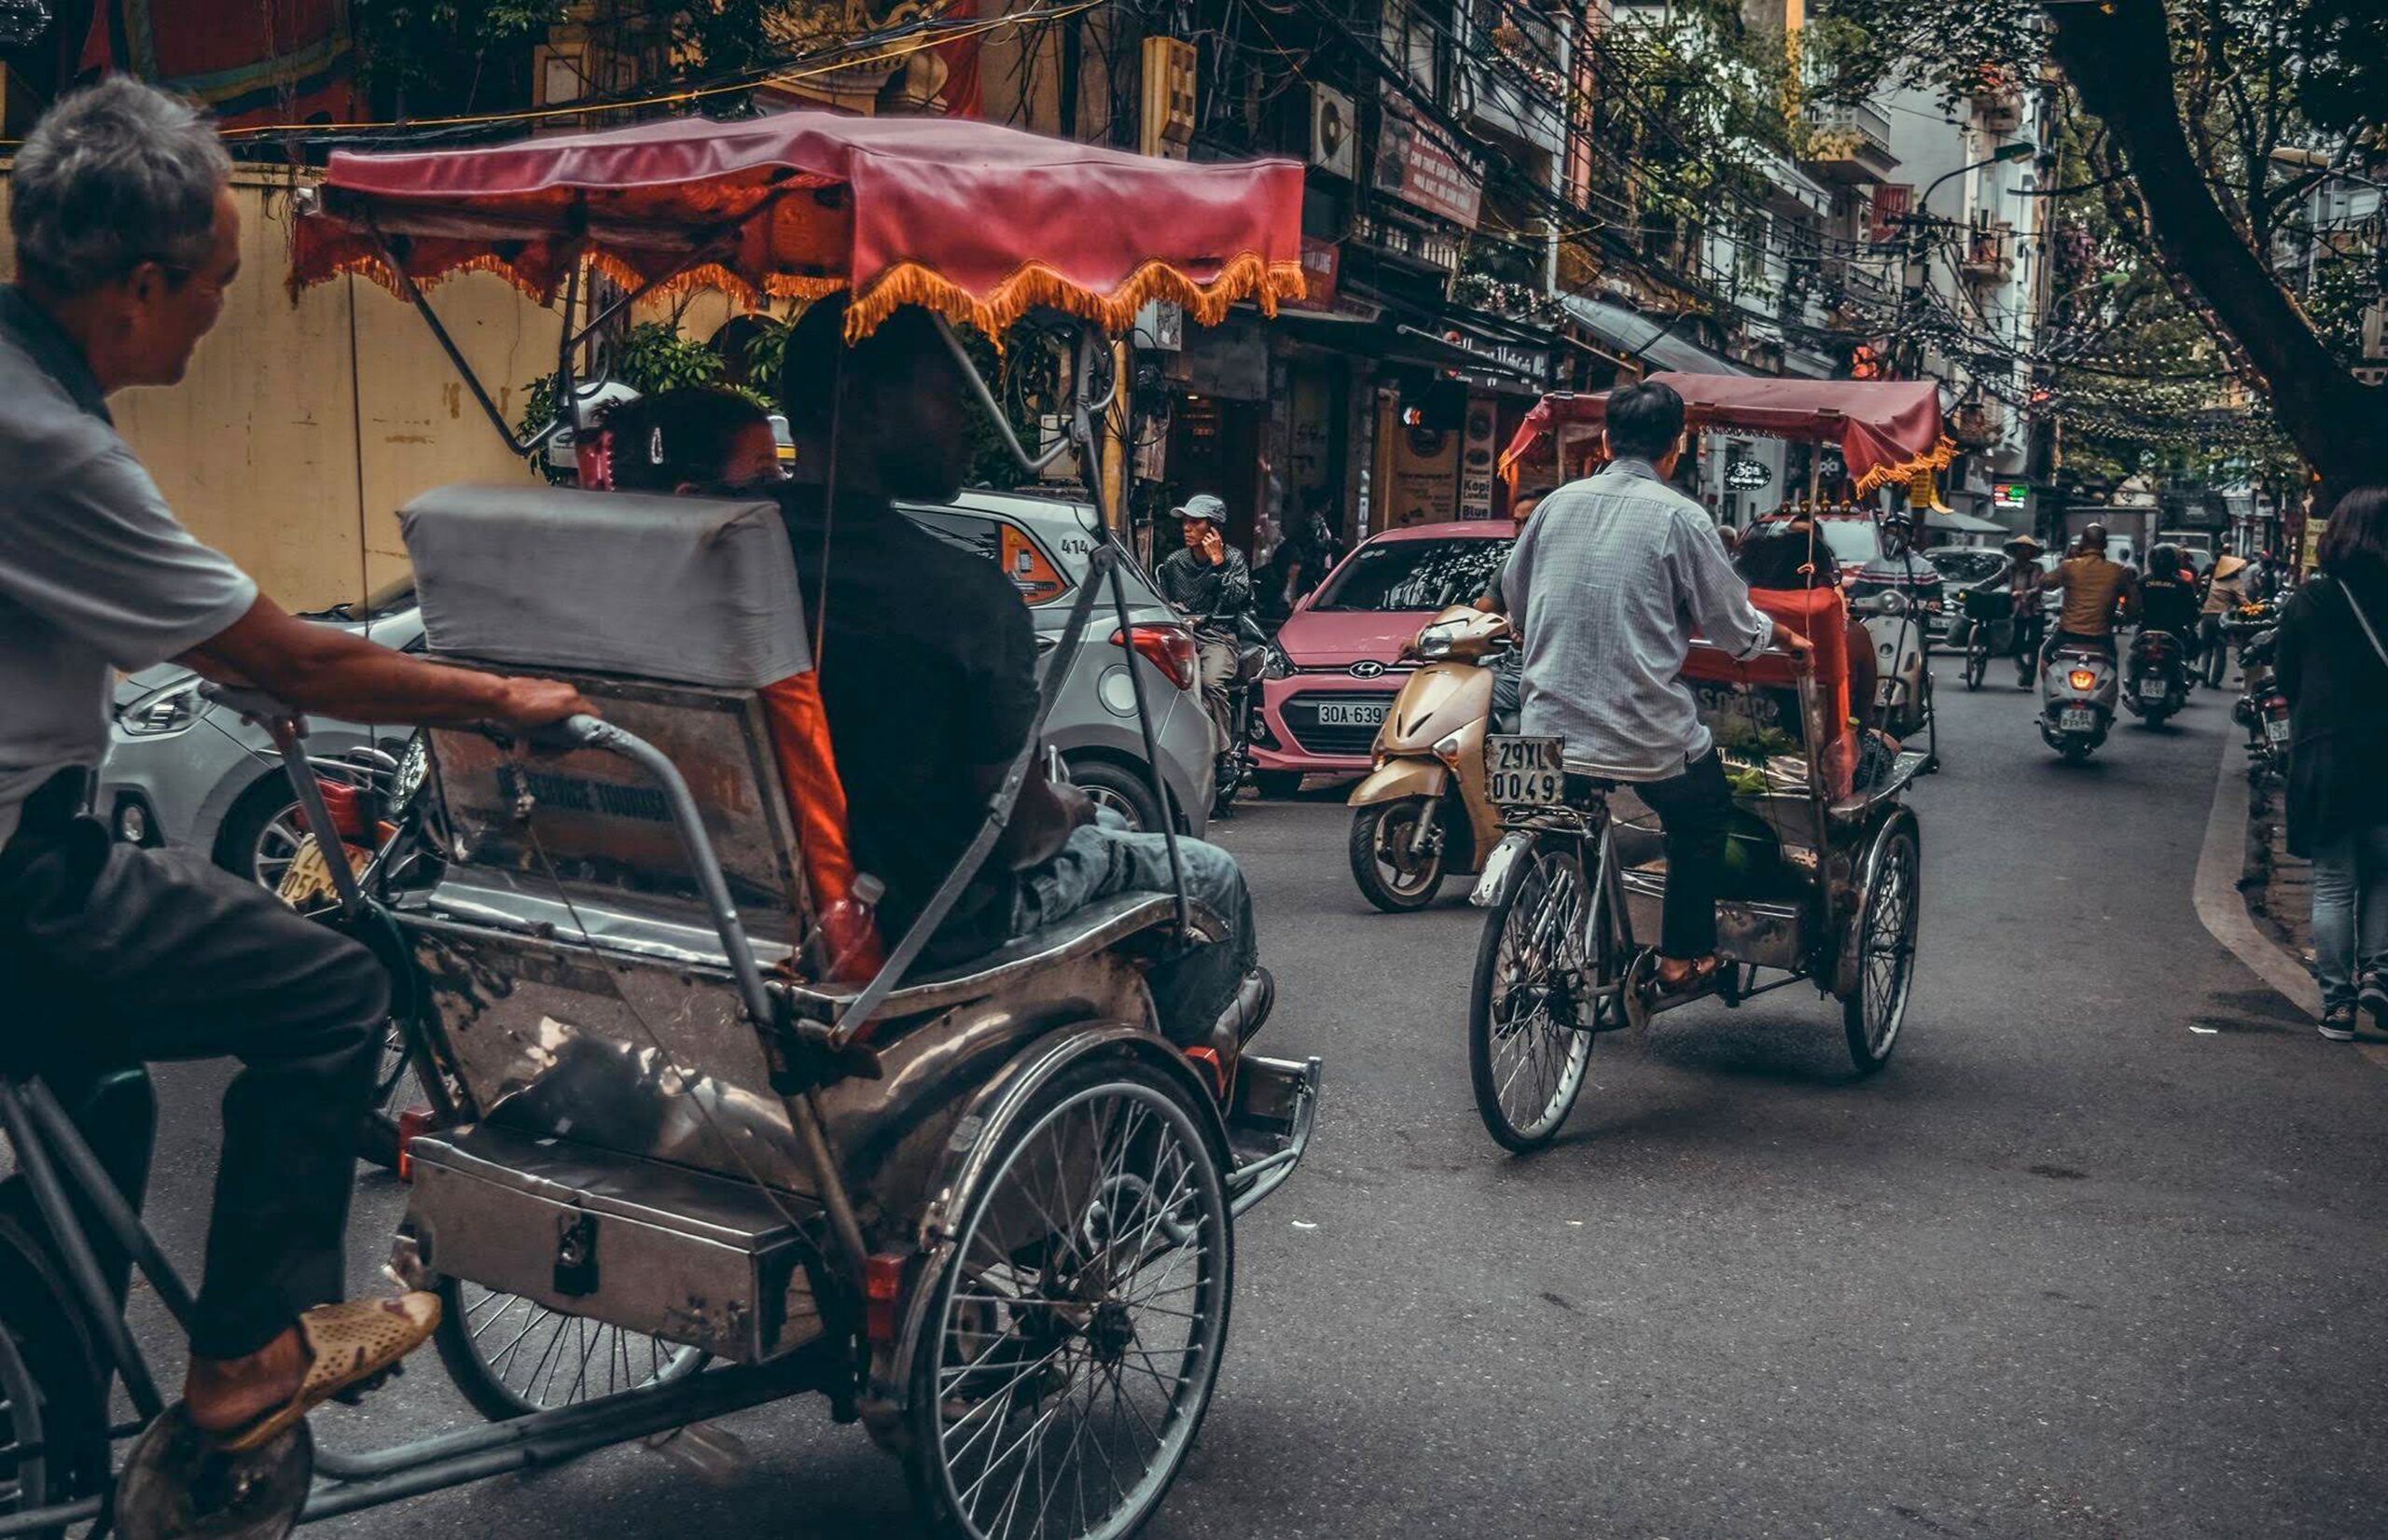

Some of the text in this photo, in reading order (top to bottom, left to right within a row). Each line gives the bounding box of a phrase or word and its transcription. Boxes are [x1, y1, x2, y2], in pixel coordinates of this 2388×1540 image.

[1463, 479, 1491, 502] Kopi
[1462, 505, 1489, 519] Blue
[1062, 538, 1090, 556] 414
[1499, 742, 1548, 770] 29XL
